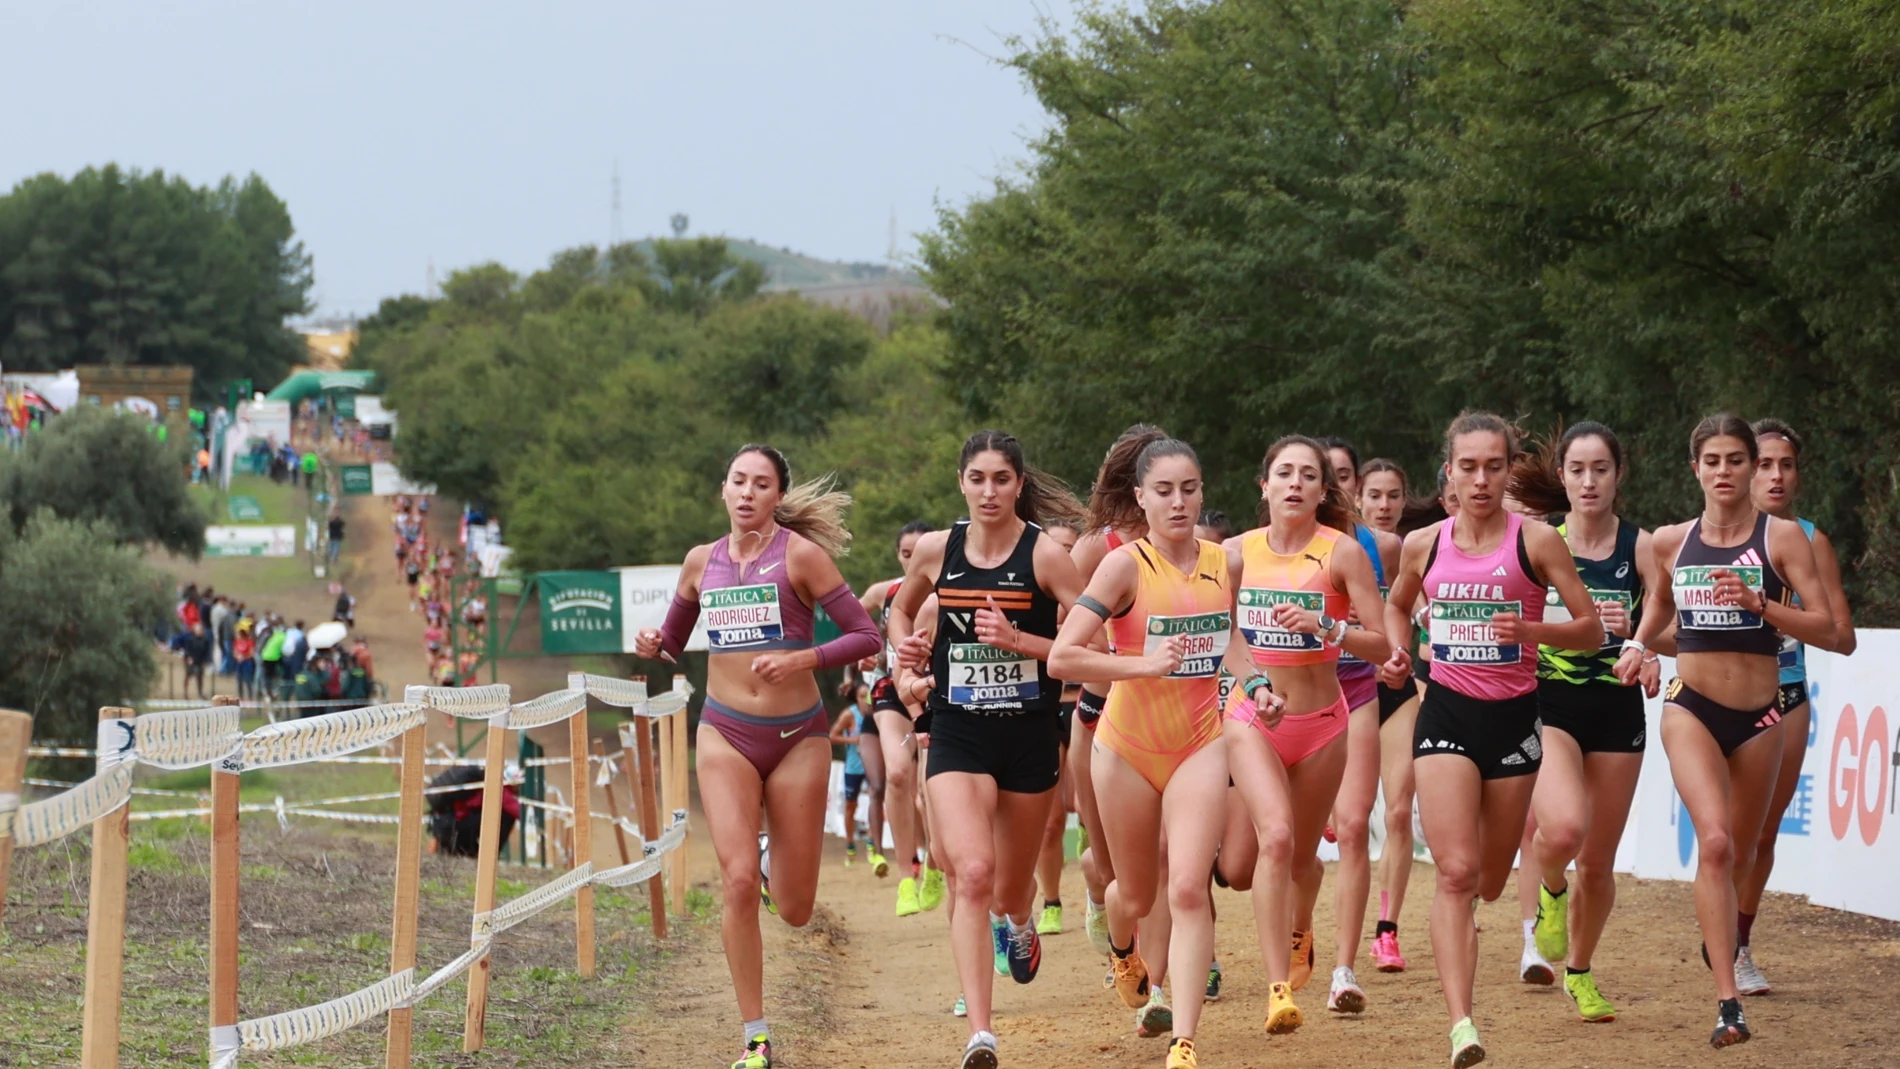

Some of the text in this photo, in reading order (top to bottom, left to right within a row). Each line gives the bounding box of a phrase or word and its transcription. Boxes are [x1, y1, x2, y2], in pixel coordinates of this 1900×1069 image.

[715, 589, 760, 604] ITÁLICA
[1437, 583, 1505, 600] BIKILA
[1255, 592, 1305, 607] ITÁLICA
[708, 607, 771, 626] RODRIGUEZ
[1248, 610, 1280, 627] GALL
[1447, 605, 1499, 618] ITÁLICA
[551, 618, 613, 631] SEVILLA
[1169, 618, 1216, 632] ITÁLICA
[968, 647, 1018, 659] ITÁLICA
[964, 663, 1023, 685] 2184
[1829, 703, 1889, 847] GO
